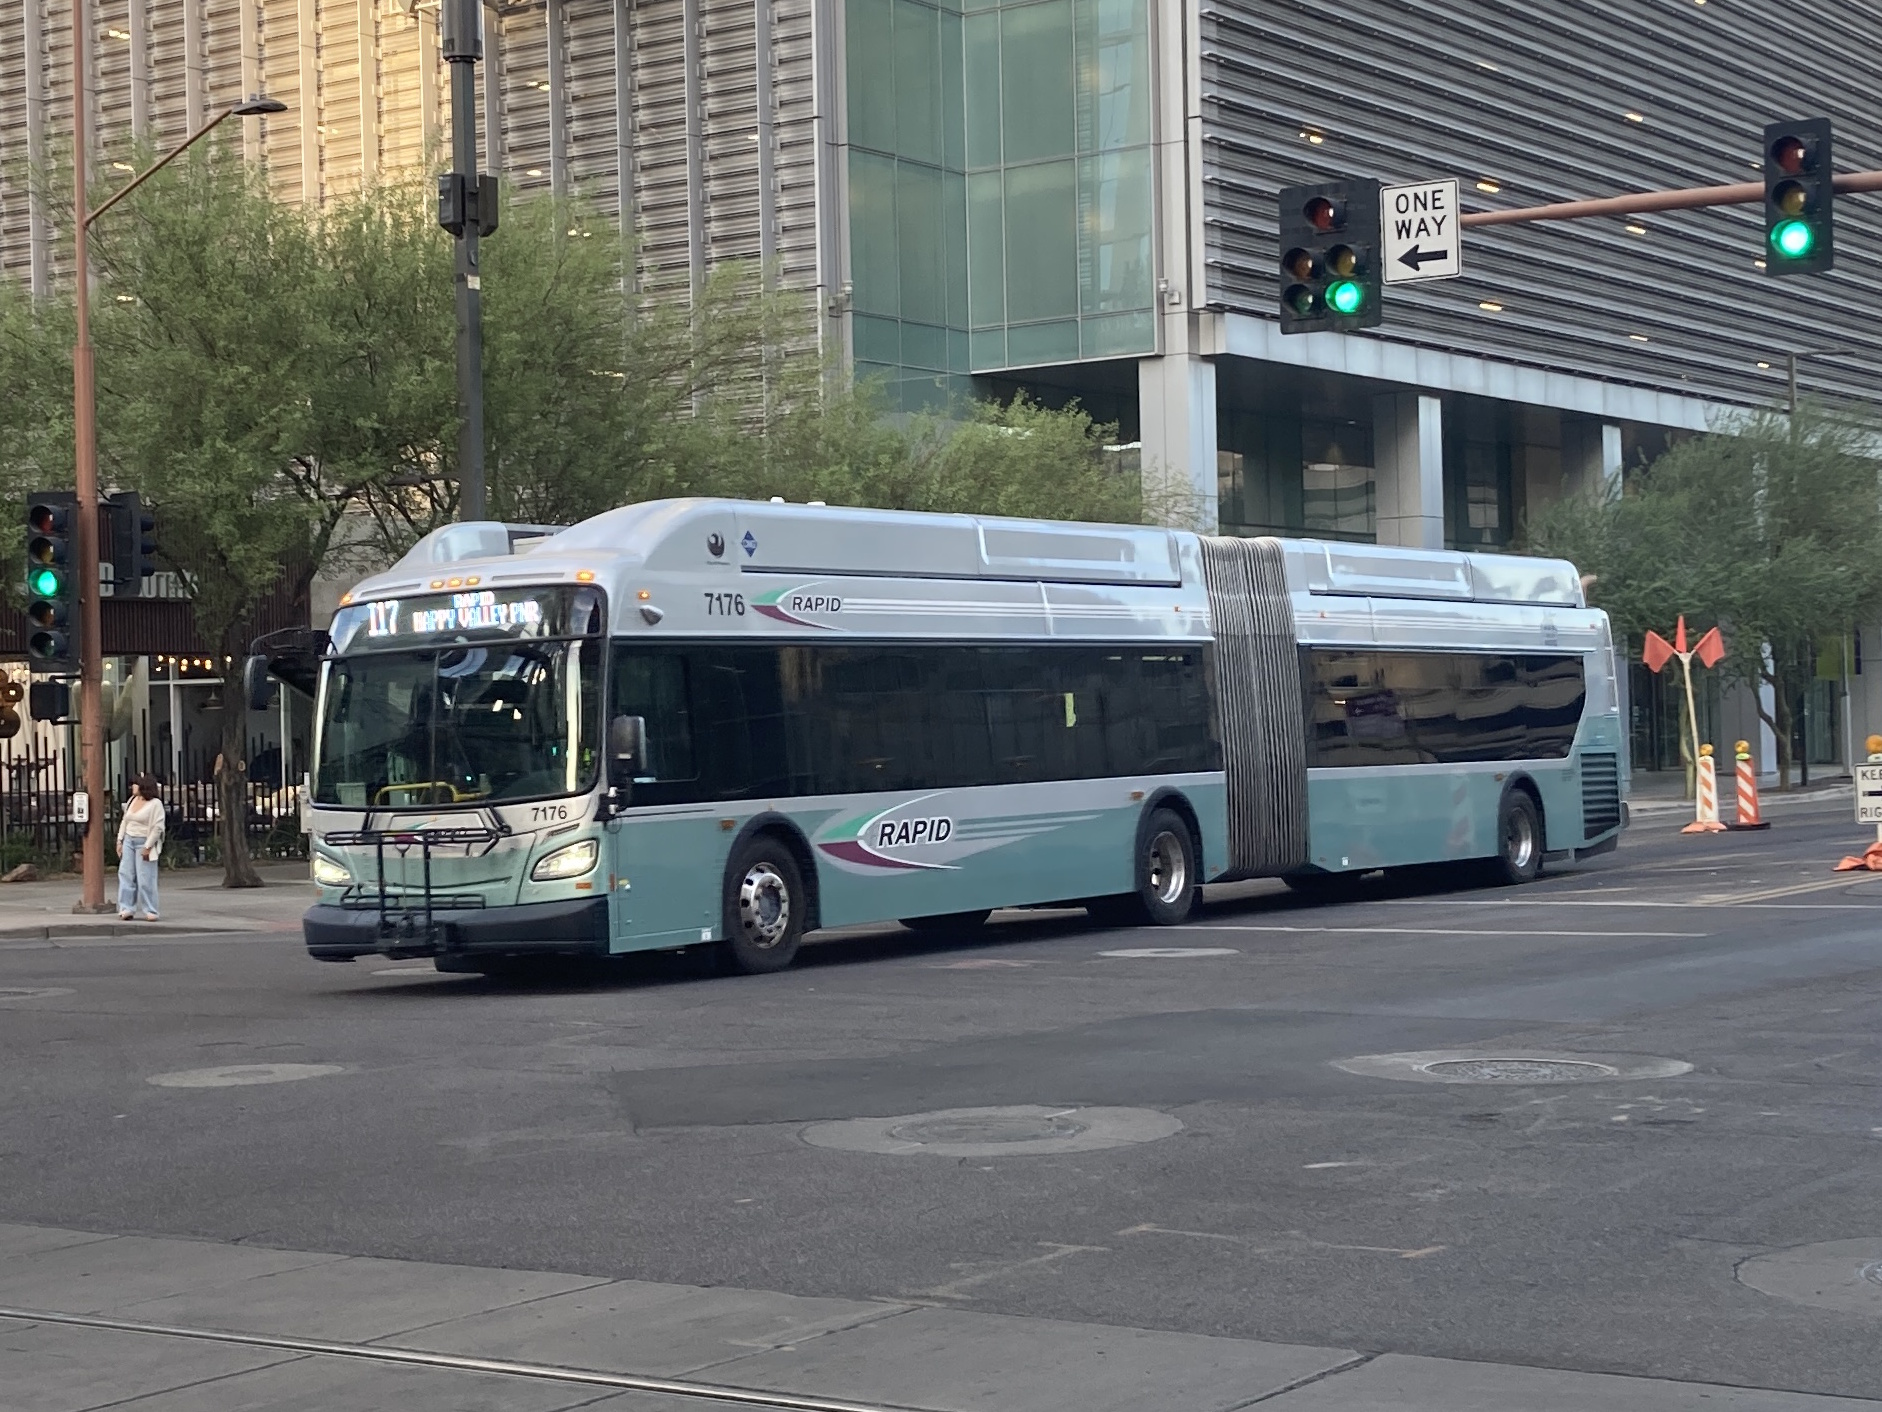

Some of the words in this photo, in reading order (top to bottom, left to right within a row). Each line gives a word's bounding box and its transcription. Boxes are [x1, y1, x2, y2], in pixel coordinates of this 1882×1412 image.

[1396, 189, 1444, 214] ONE
[1395, 215, 1447, 240] WAY
[452, 591, 495, 608] RAPID
[704, 593, 745, 616] 7176
[792, 596, 841, 612] RAPID
[413, 609, 456, 632] HAPPY
[458, 603, 508, 629] VALLEY
[531, 805, 567, 822] 7176
[878, 817, 951, 847] RAPID
